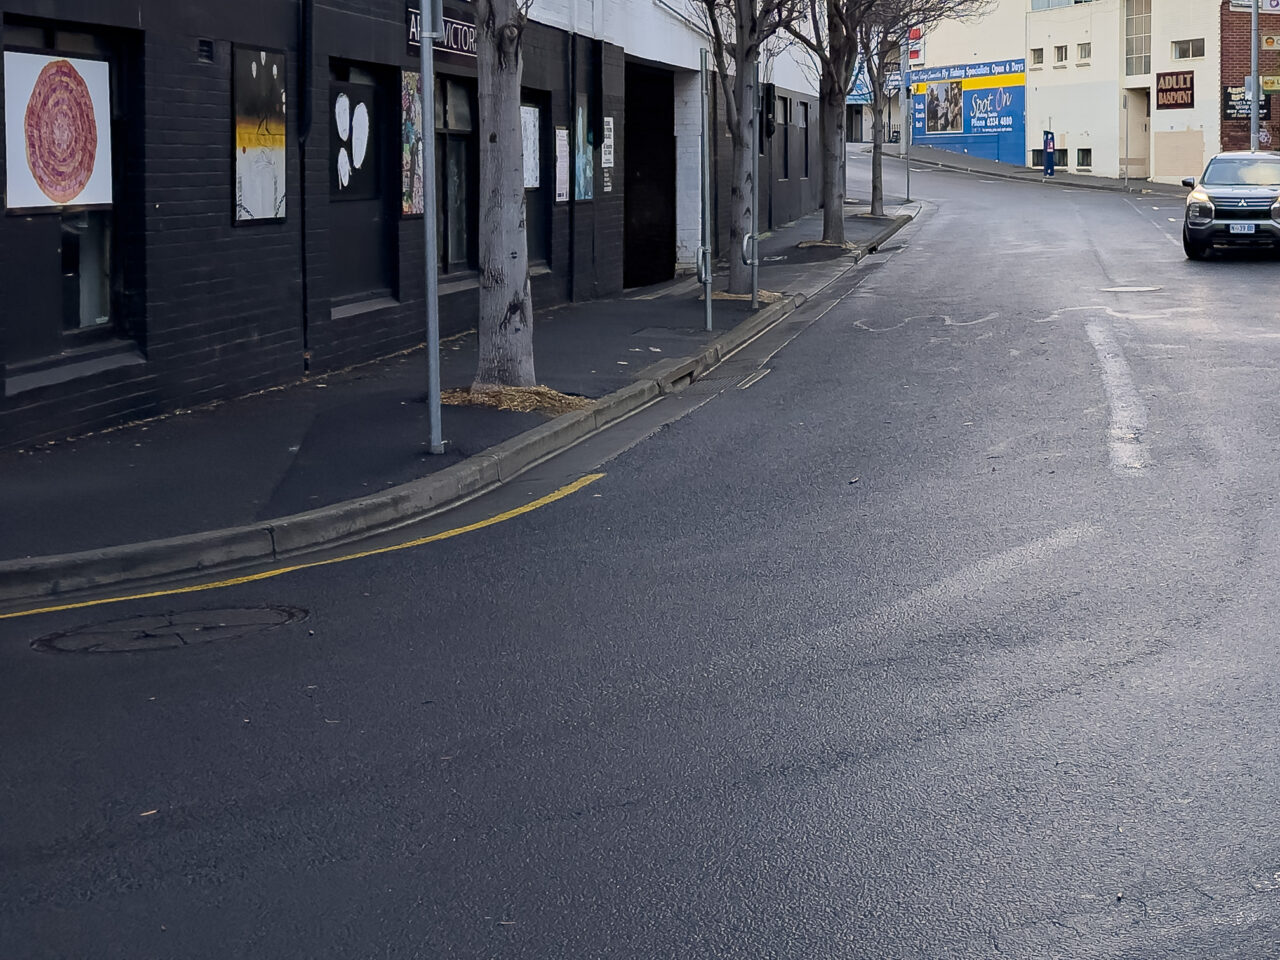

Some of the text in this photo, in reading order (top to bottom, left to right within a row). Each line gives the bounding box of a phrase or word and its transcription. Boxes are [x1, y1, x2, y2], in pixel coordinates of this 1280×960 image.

[966, 65, 990, 77] Specialists
[991, 63, 1004, 75] Open
[1006, 63, 1009, 72] 6
[1011, 62, 1024, 72] Days
[1158, 74, 1192, 89] ADULT
[970, 87, 1013, 118] Spot On
[1158, 91, 1192, 105] BASEMENT
[971, 118, 985, 126] Phone
